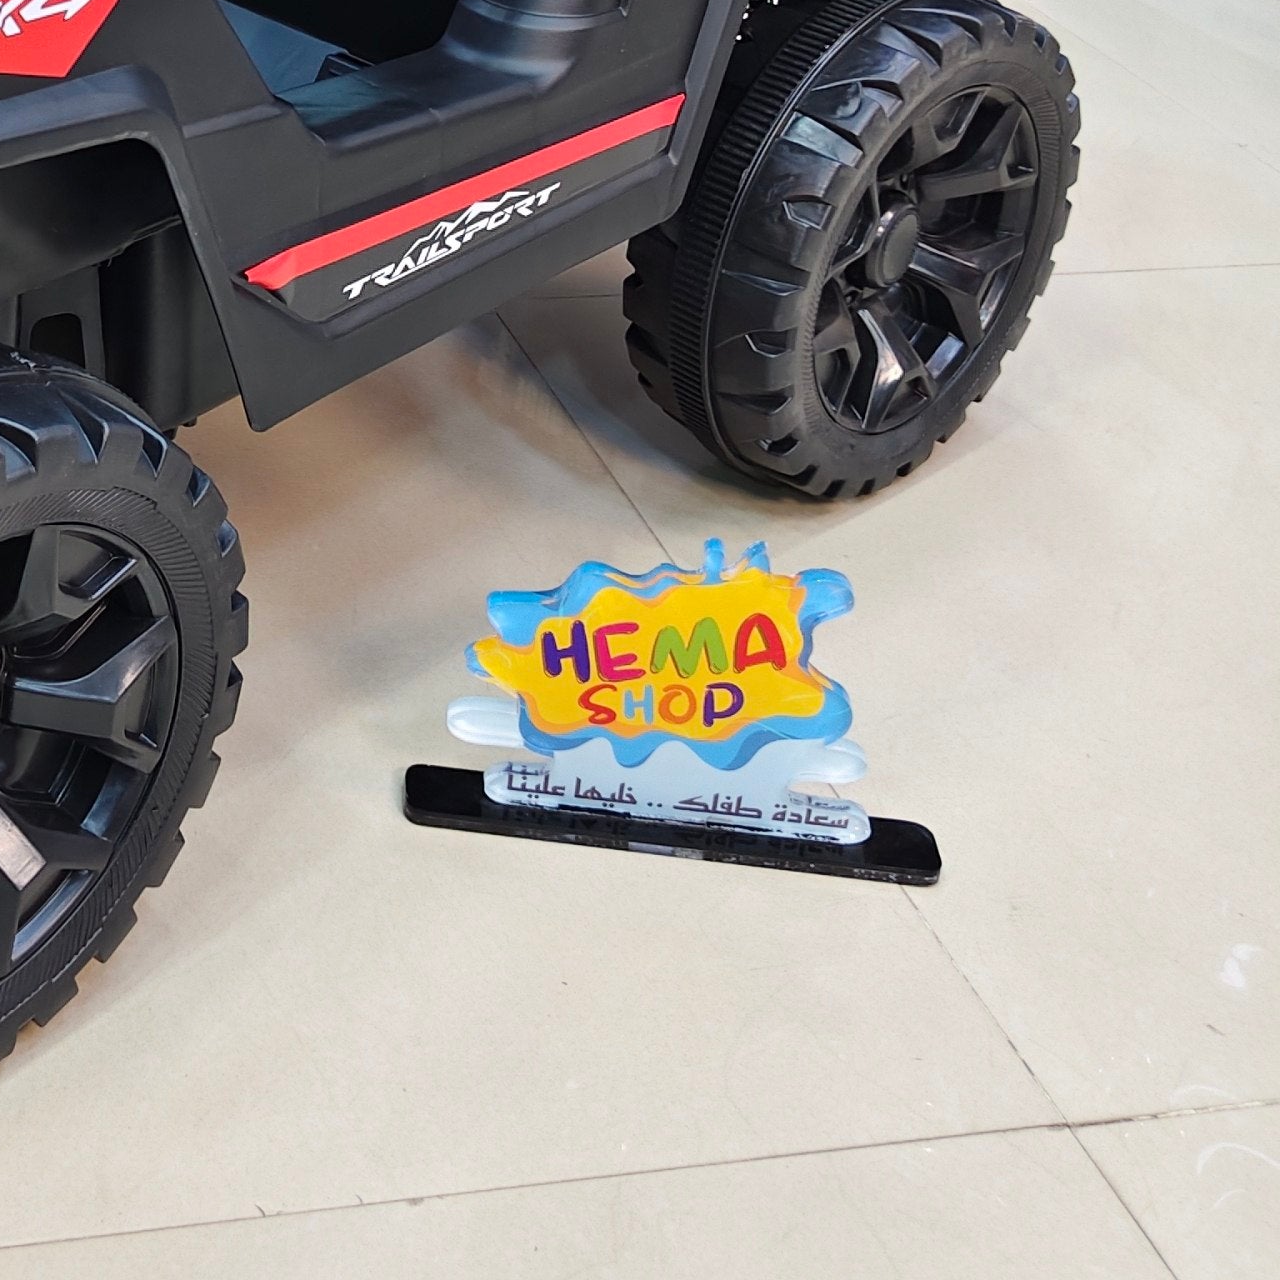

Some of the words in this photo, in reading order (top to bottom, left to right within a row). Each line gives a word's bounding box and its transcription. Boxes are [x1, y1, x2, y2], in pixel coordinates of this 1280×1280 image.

[343, 182, 561, 301] TRAILSPORT
[541, 613, 787, 683] HEMA
[578, 683, 746, 728] SHOP
[506, 773, 566, 799] علينا
[574, 777, 639, 808] خليها
[673, 793, 764, 820] طفلك
[772, 803, 851, 830] سعادة
